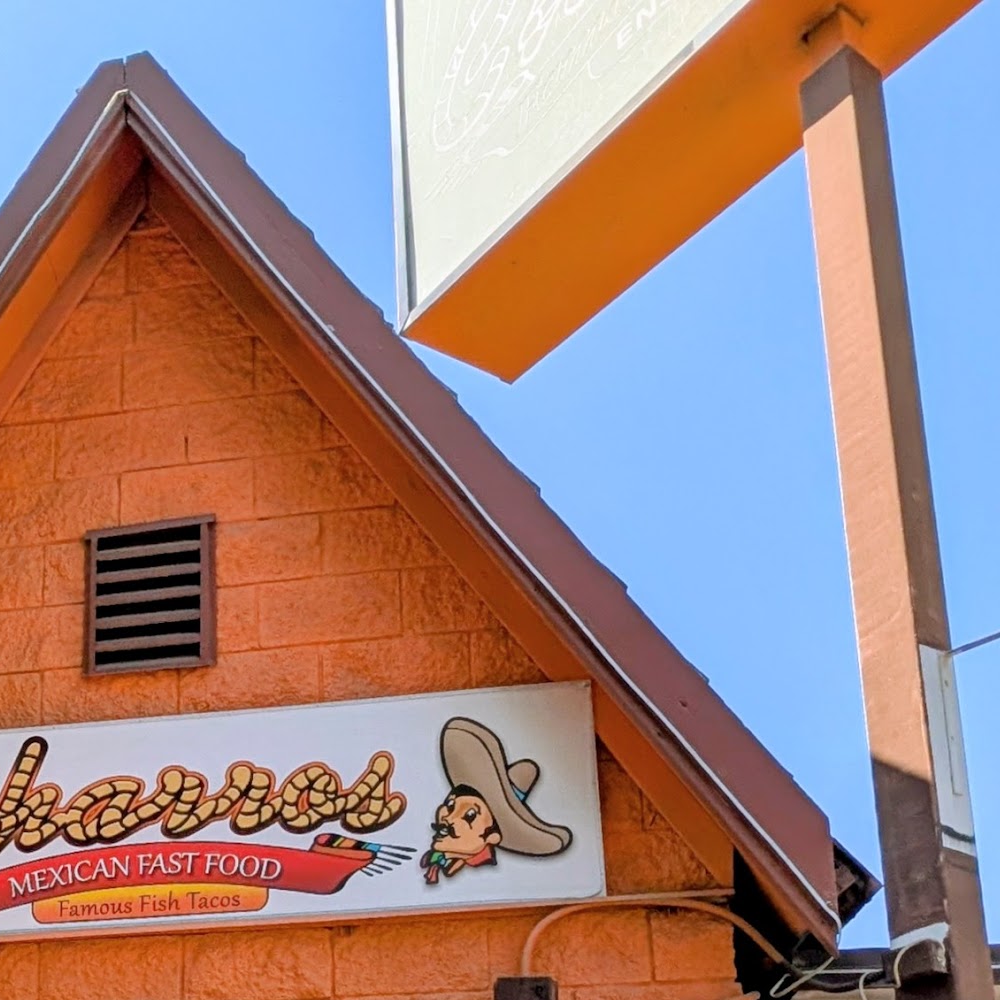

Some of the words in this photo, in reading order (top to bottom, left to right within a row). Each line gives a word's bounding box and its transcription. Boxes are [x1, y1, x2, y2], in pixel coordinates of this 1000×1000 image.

[8, 855, 130, 898] MEXICAN
[137, 851, 199, 876] FAST
[204, 853, 282, 880] FOOD
[58, 899, 133, 918] Famous
[139, 893, 181, 913] Fish
[186, 890, 241, 910] Tacos
